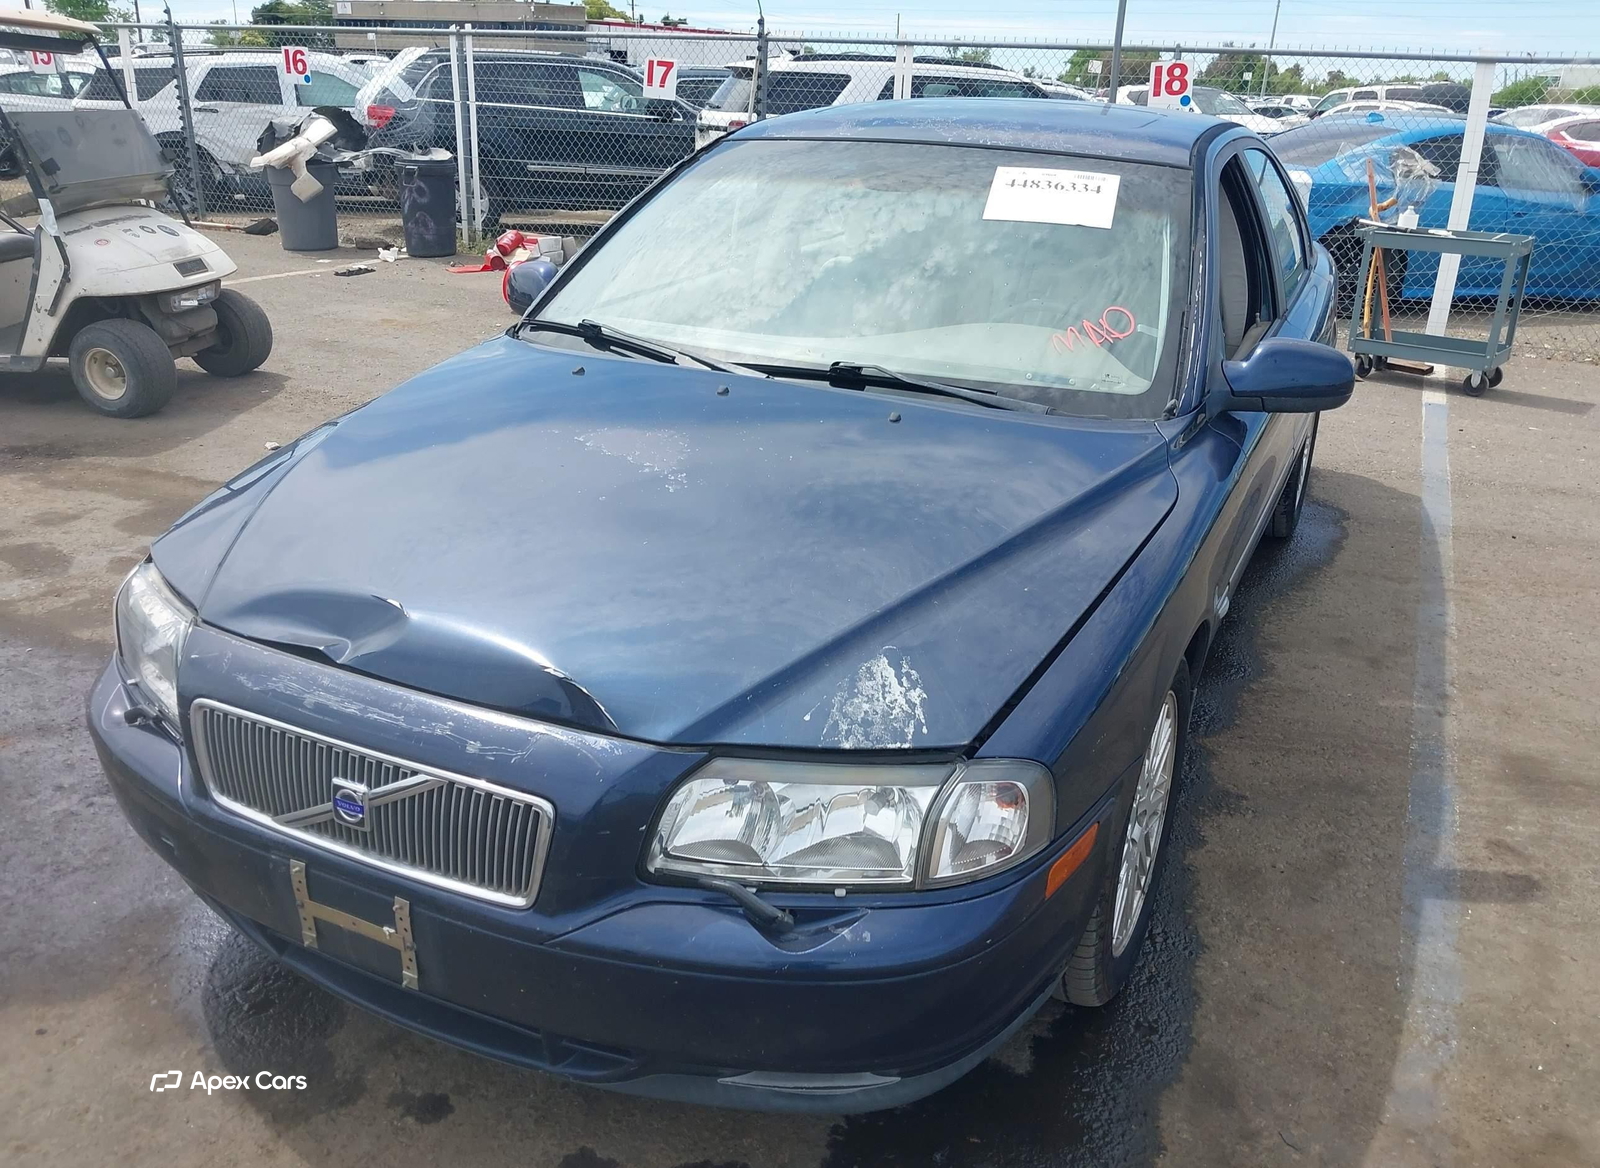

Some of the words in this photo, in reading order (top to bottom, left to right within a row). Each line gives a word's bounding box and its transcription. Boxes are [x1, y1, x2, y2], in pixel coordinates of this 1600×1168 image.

[283, 48, 308, 75] 16
[646, 59, 675, 88] 17
[1152, 62, 1189, 97] 18
[1004, 178, 1103, 195] 44836334
[336, 800, 362, 812] VOLVO
